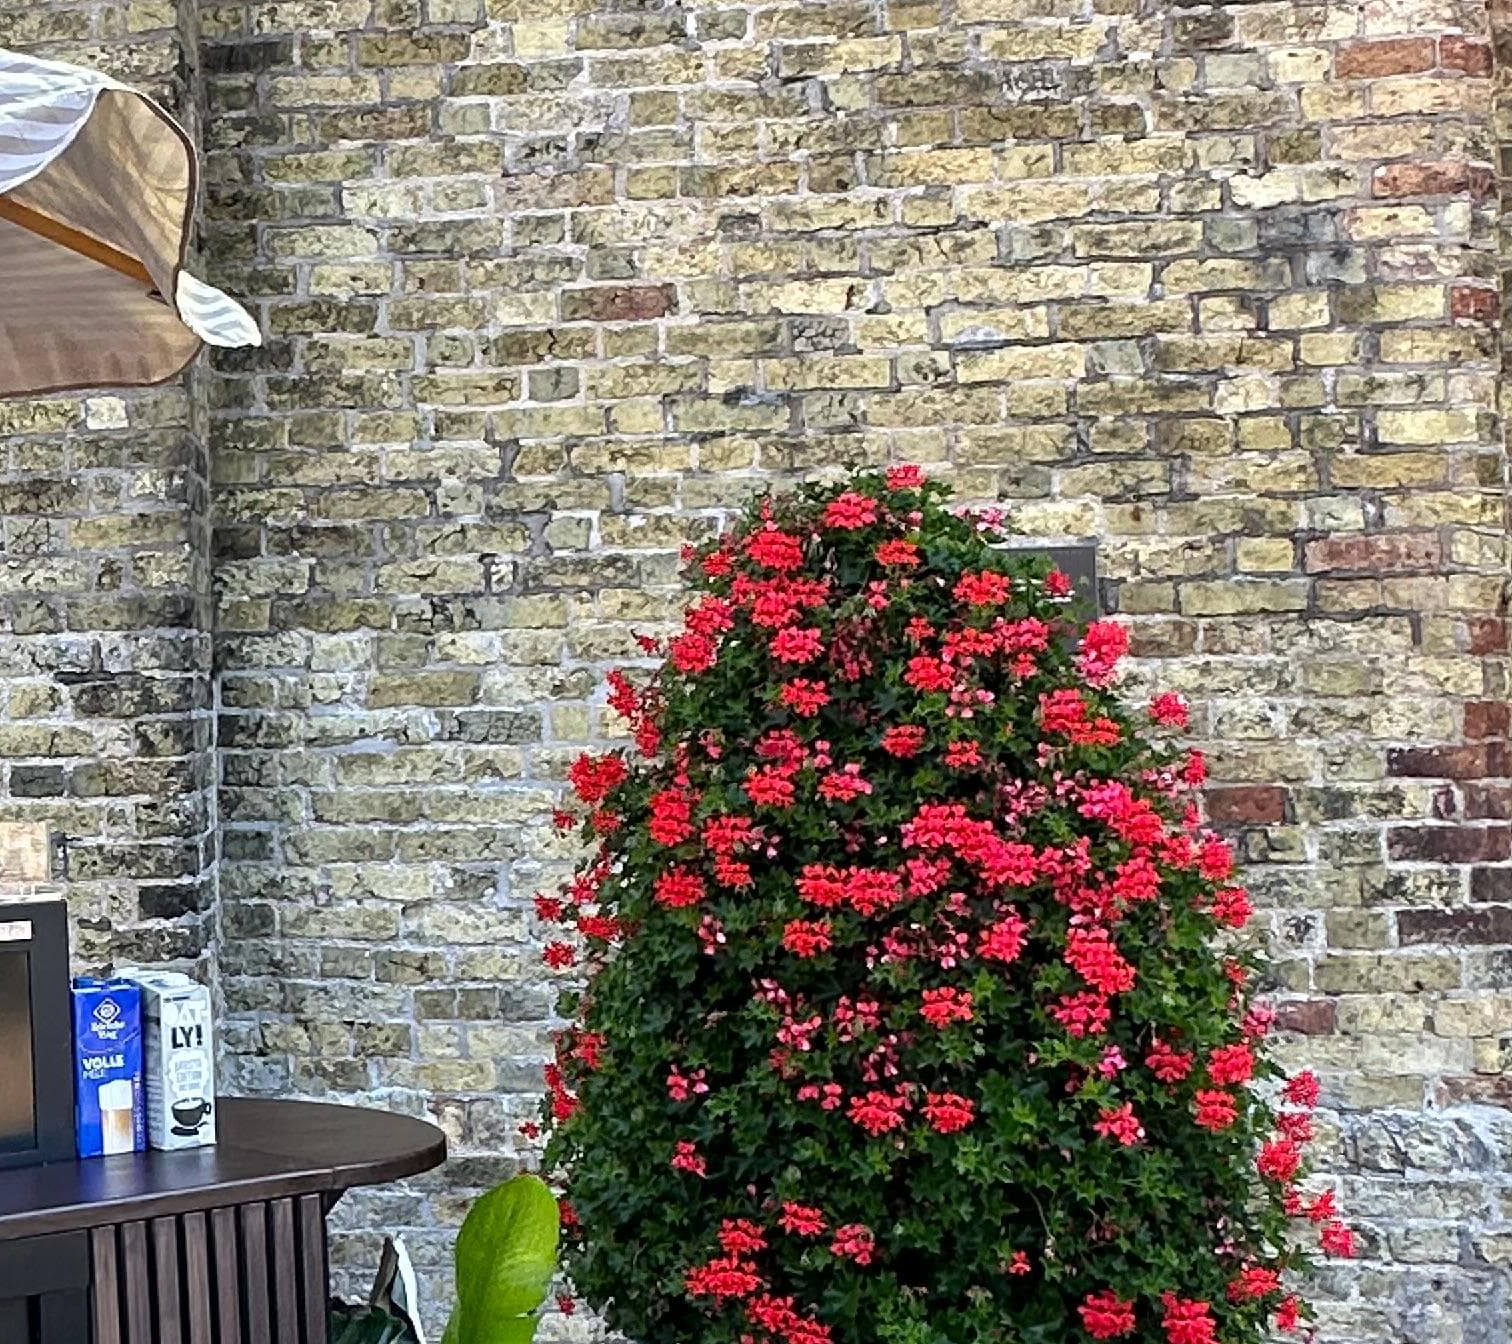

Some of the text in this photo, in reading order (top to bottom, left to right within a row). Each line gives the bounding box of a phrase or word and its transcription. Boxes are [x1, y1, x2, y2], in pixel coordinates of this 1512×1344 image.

[163, 1000, 207, 1026] OAT
[172, 1025, 203, 1049] LY!
[82, 1054, 125, 1070] VOLLE
